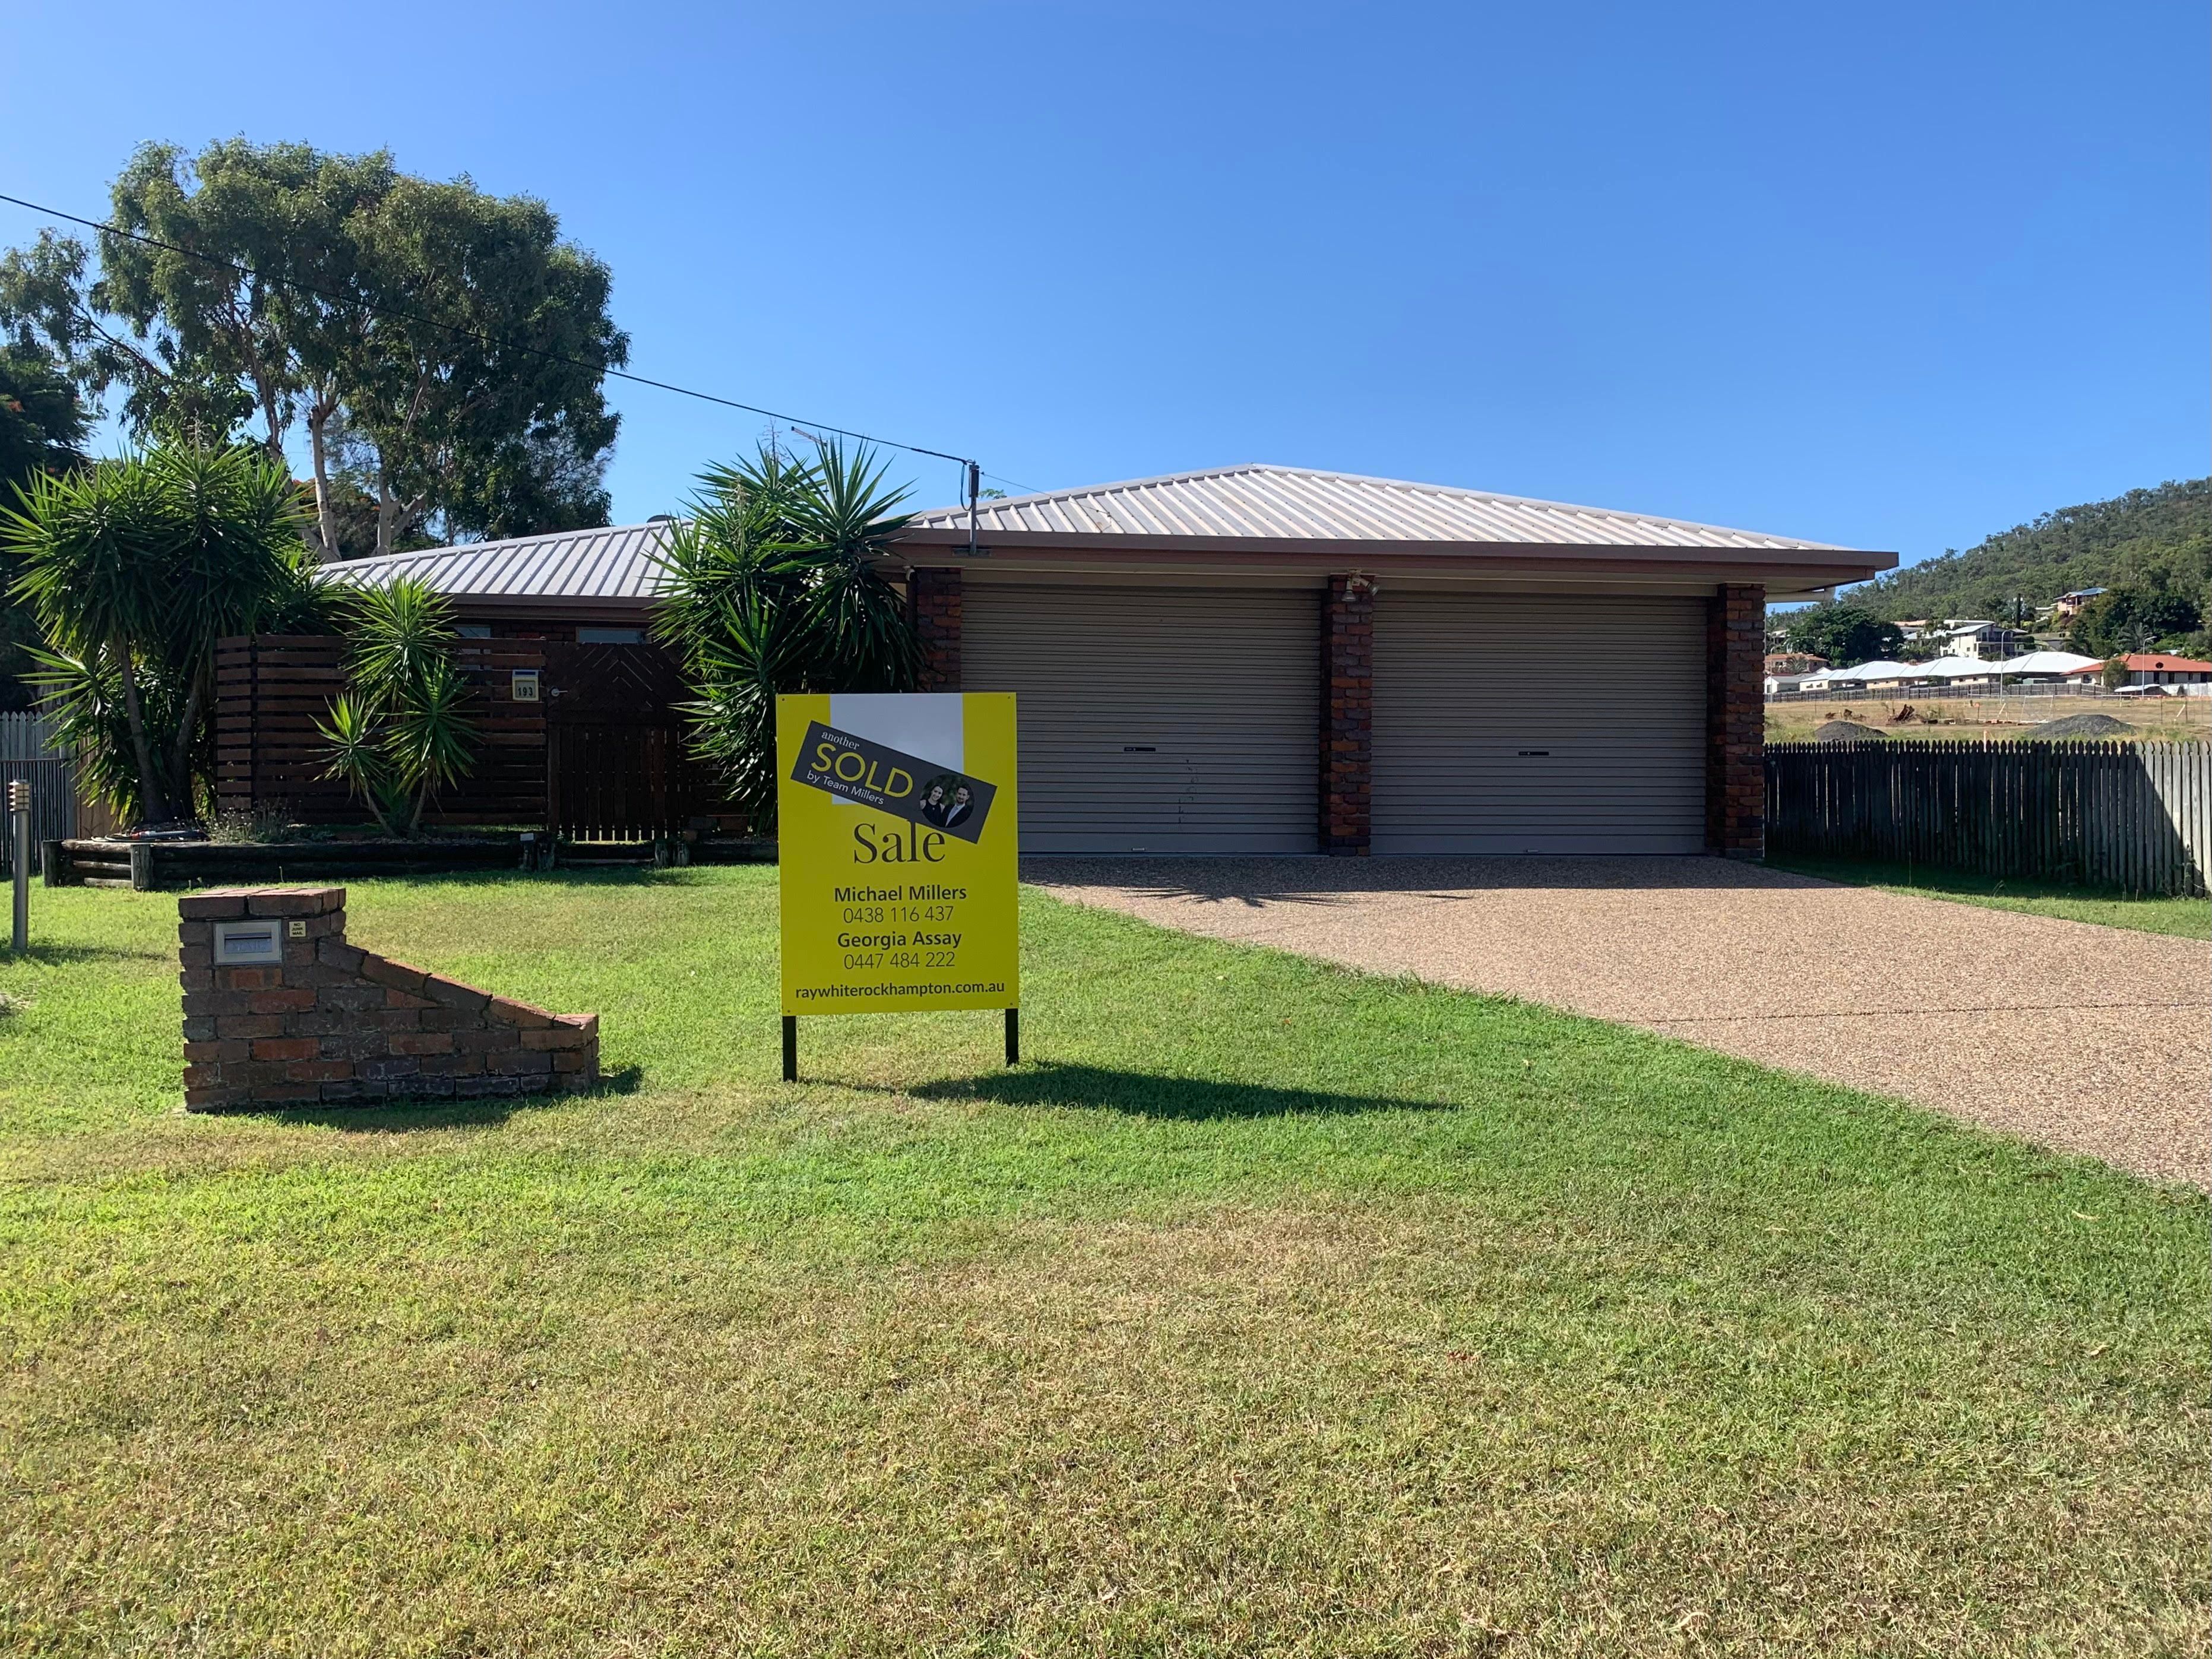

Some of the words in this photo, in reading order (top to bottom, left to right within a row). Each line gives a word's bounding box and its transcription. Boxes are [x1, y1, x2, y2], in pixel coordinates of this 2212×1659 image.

[518, 687, 533, 696] 193
[821, 731, 860, 750] another
[811, 743, 913, 797] SOLD
[807, 770, 820, 783] by
[824, 775, 849, 793] Team
[851, 786, 884, 805] Millers
[853, 820, 946, 863] Sale
[834, 885, 902, 902] Michael
[909, 884, 967, 900] Millers
[843, 907, 884, 923] 0438
[891, 906, 919, 922] 116
[925, 906, 954, 921] 437
[837, 931, 907, 950] Georgia
[912, 930, 962, 948] Assay
[844, 954, 884, 970] 0447
[890, 952, 920, 968] 484
[925, 951, 955, 967] 222
[796, 982, 1005, 1001] raywhiterockhampton.com.au
